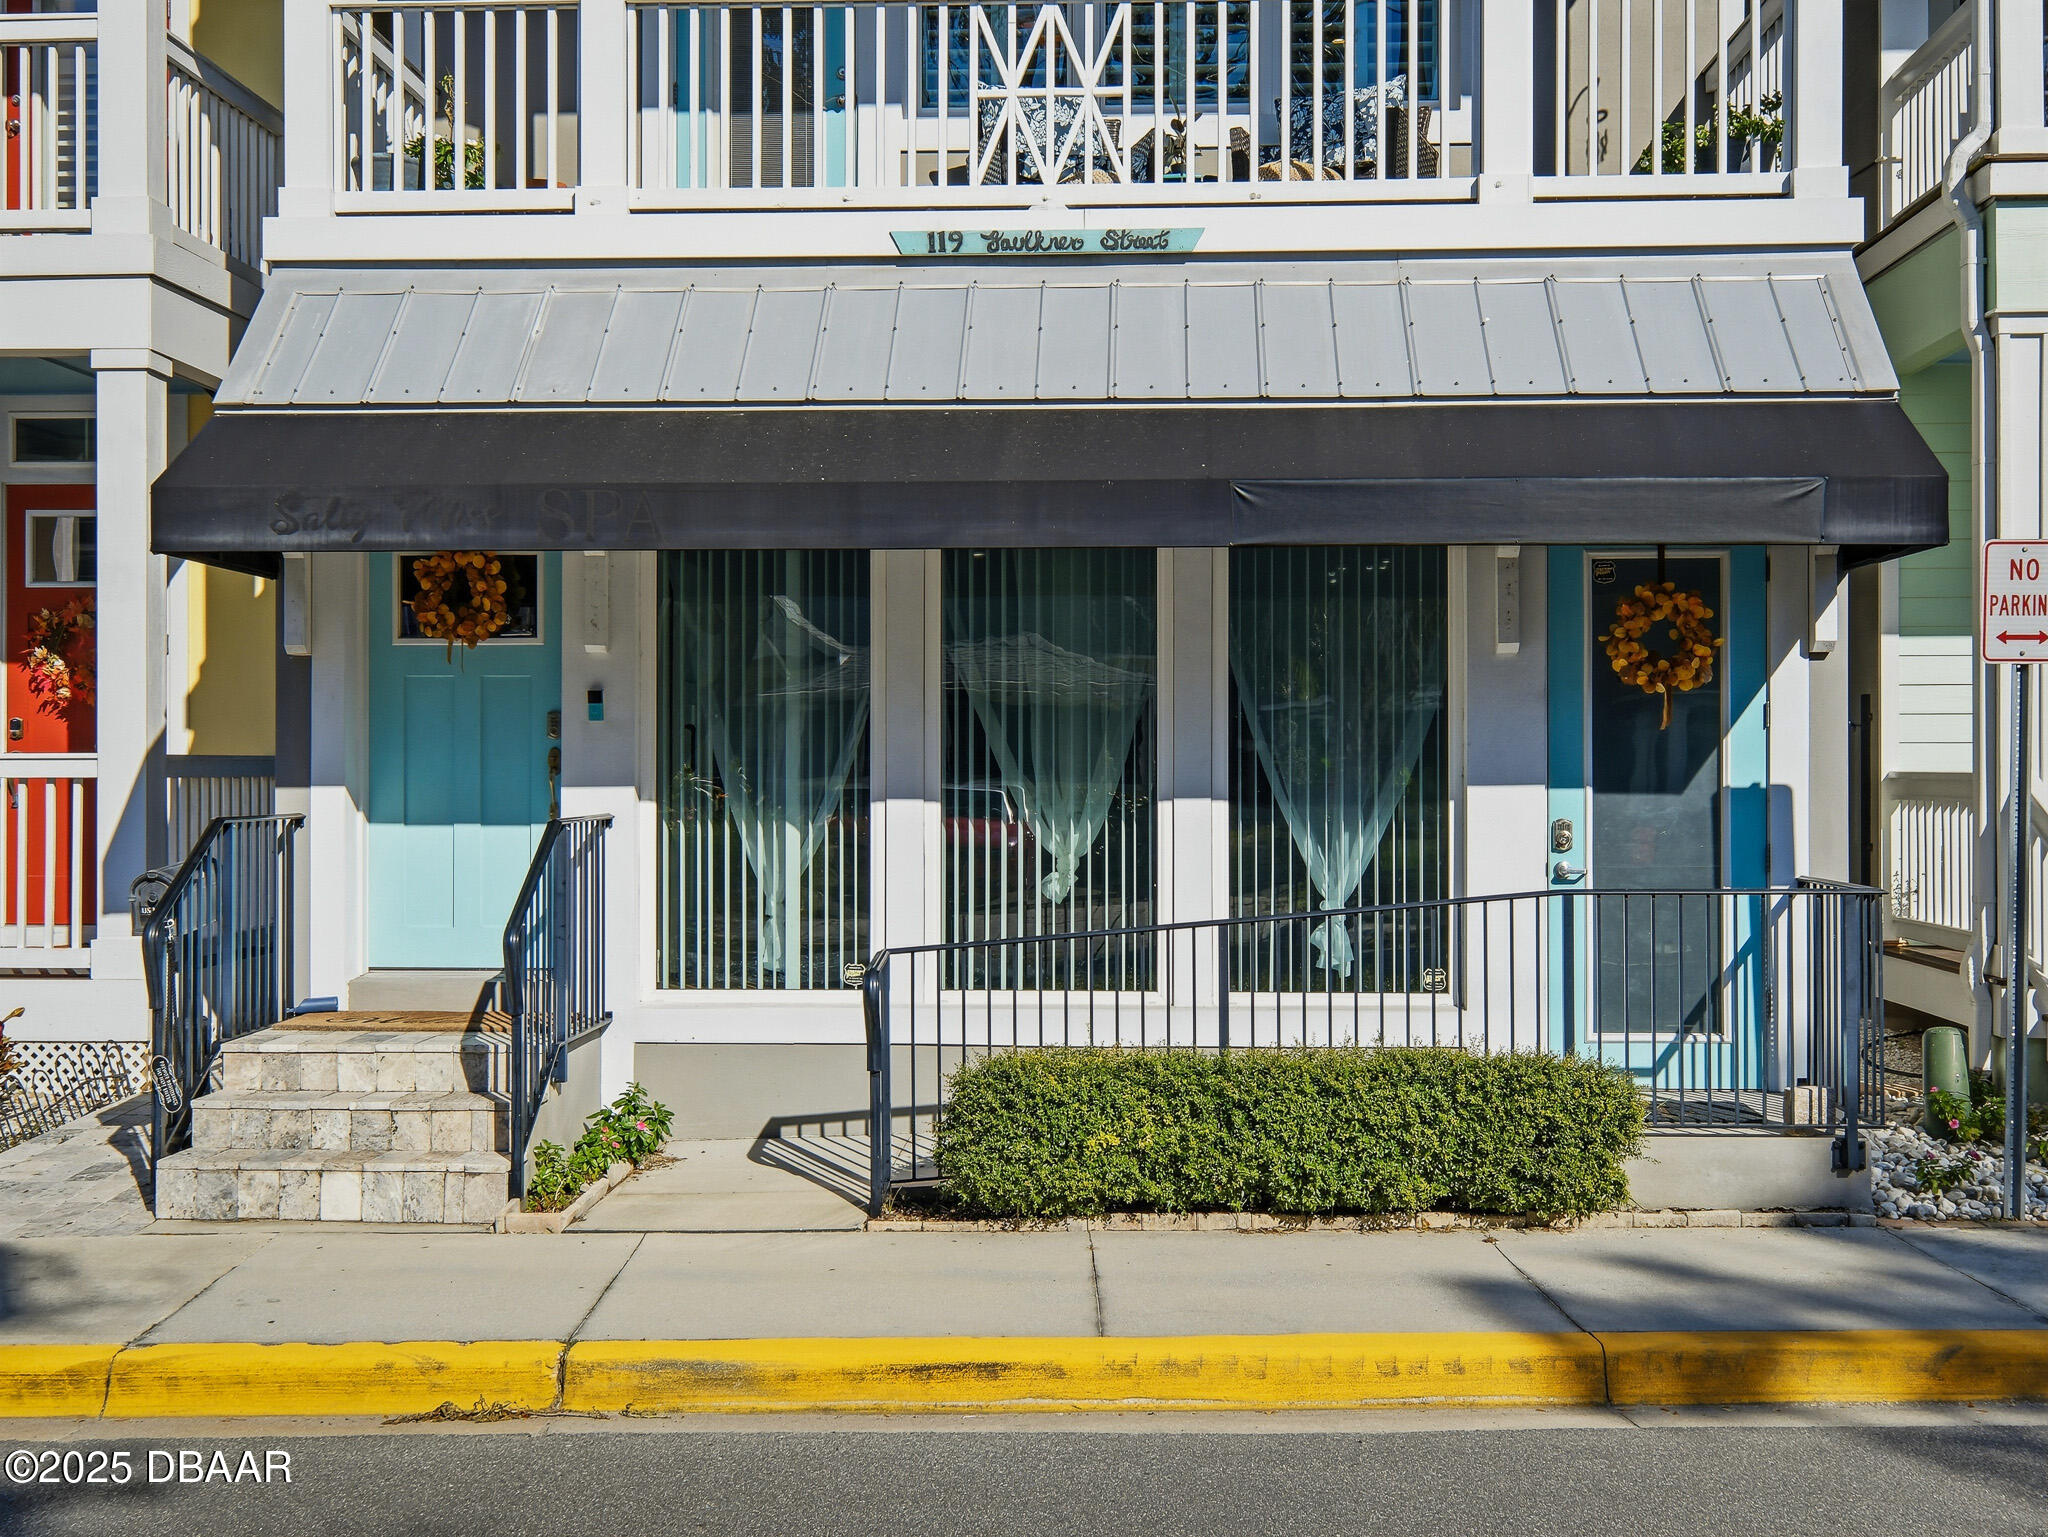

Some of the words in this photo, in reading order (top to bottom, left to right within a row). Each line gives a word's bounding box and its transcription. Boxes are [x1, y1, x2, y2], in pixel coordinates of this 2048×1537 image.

[926, 230, 964, 253] 119
[980, 229, 1085, 253] Faulkner
[1100, 229, 1171, 251] Street
[538, 488, 664, 542] SPA
[2009, 558, 2040, 581] NO
[1989, 594, 2048, 616] PARKIN
